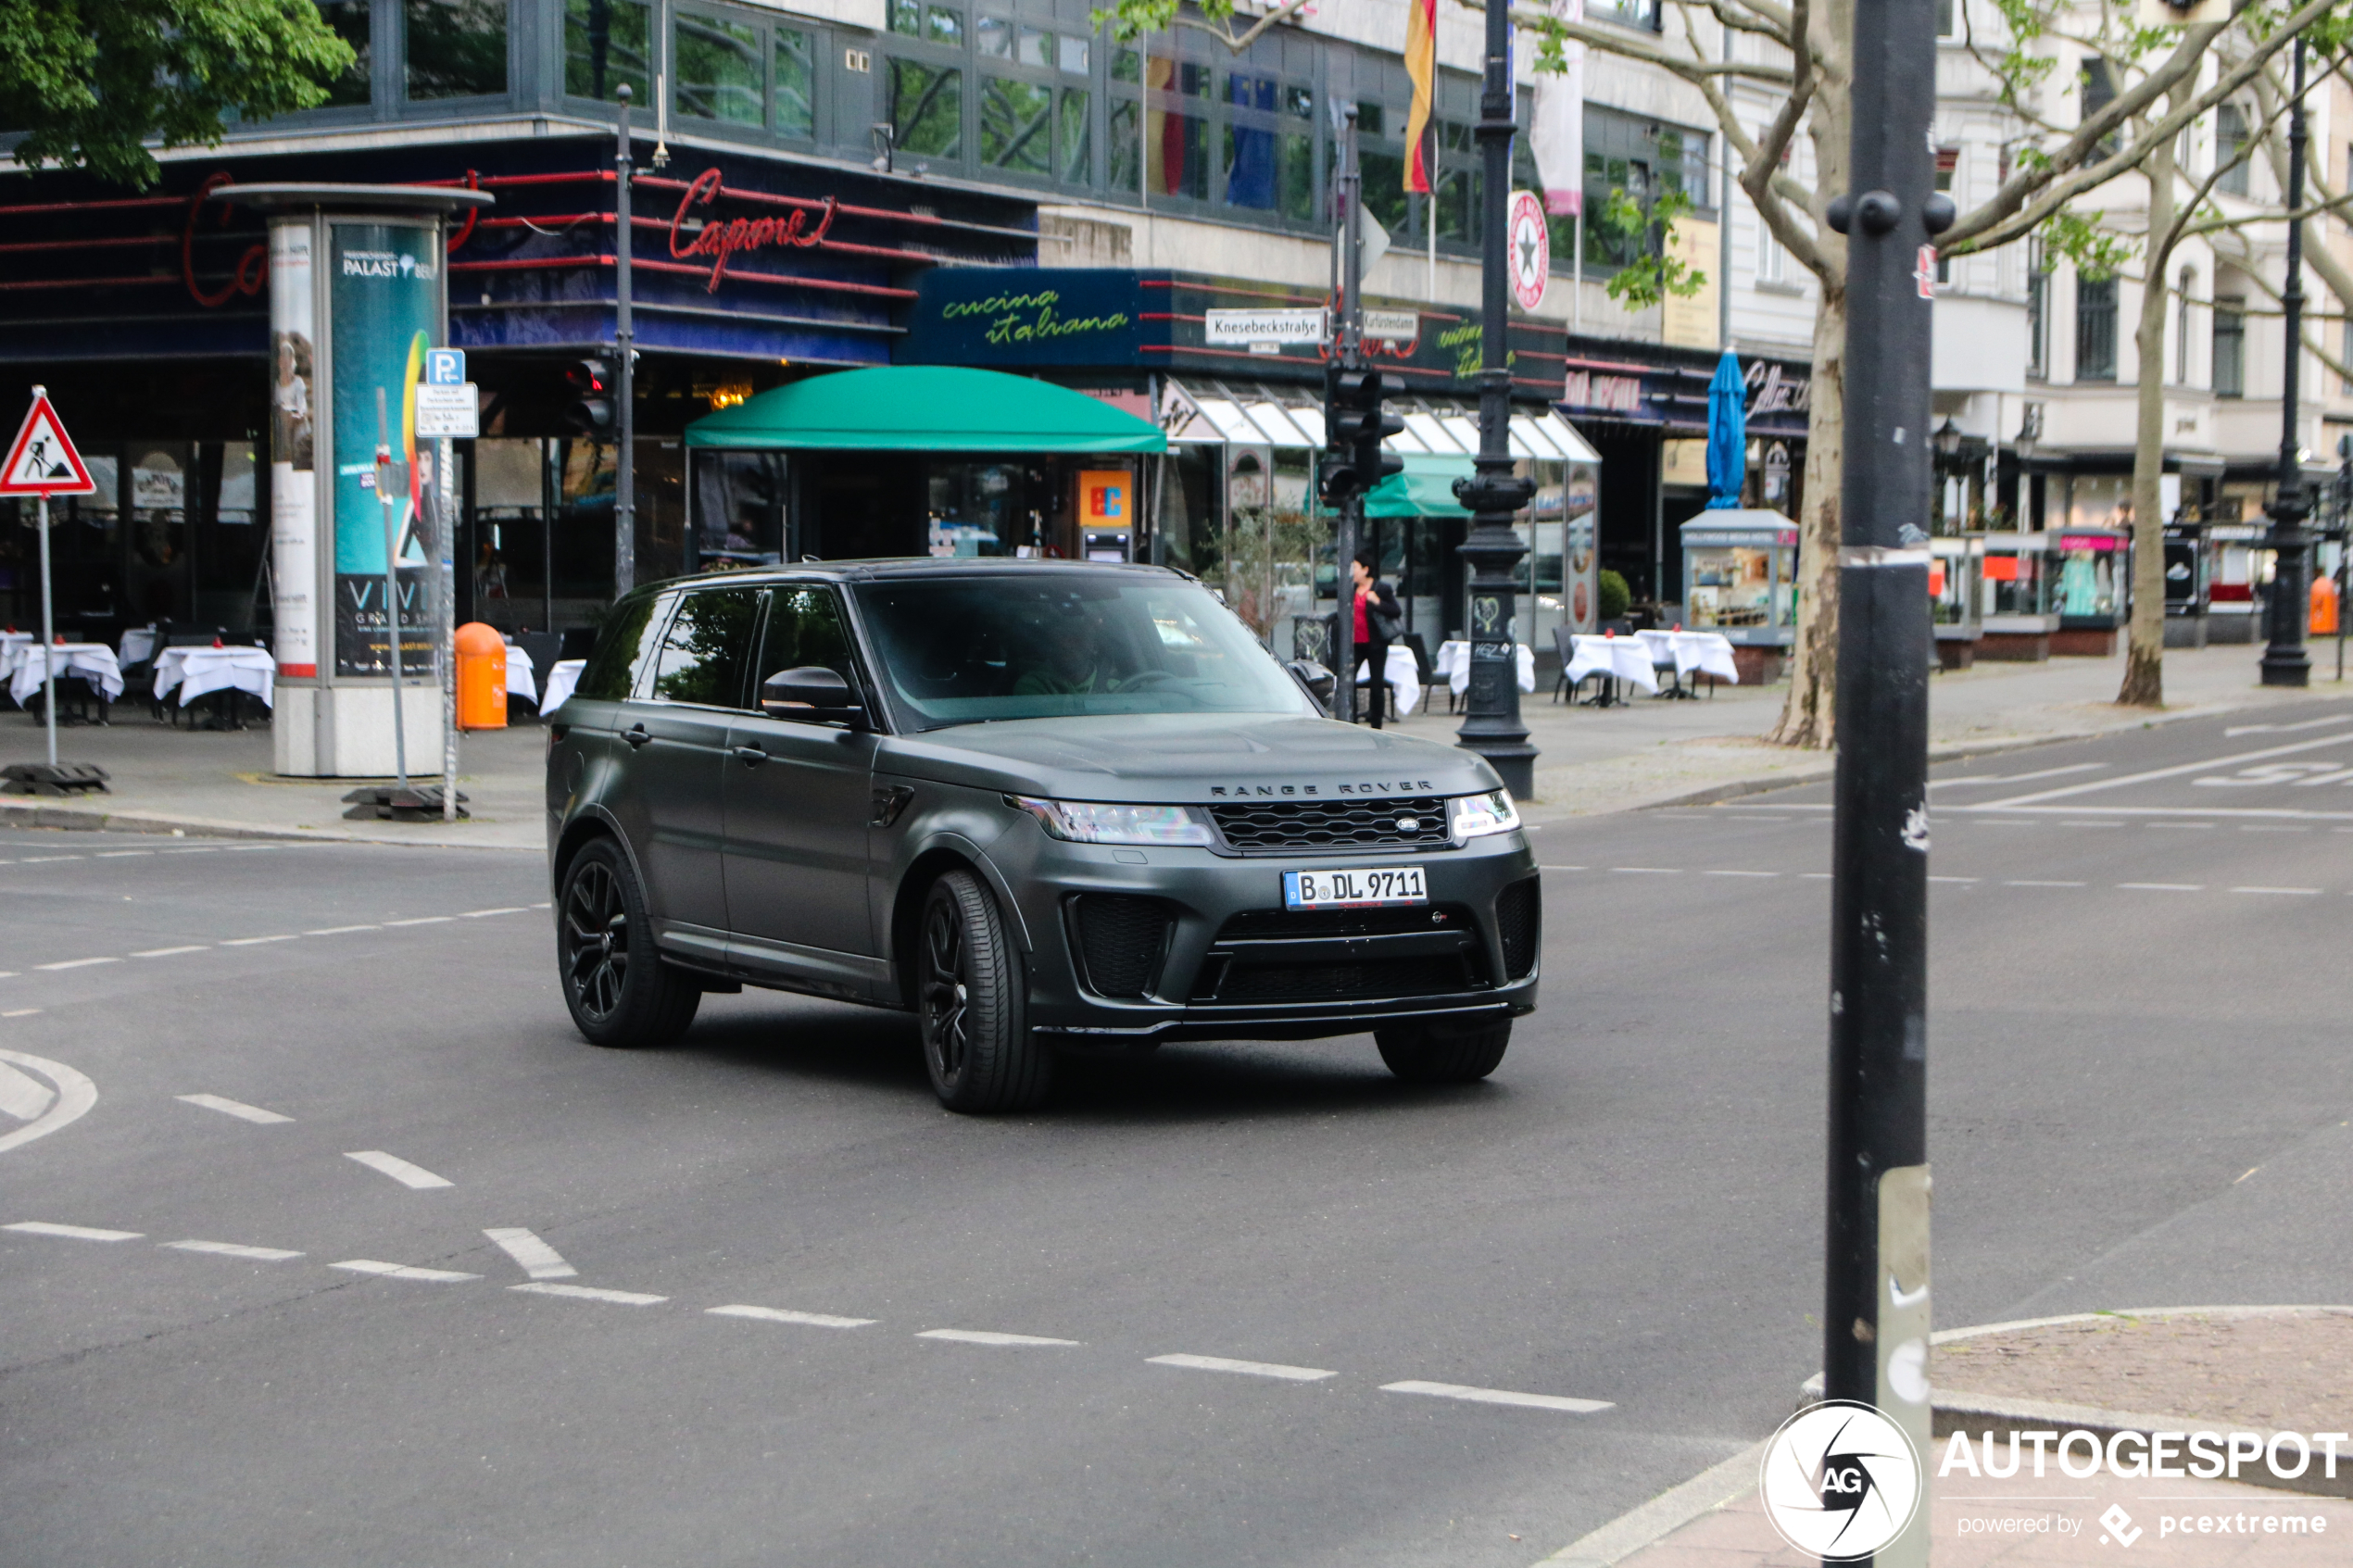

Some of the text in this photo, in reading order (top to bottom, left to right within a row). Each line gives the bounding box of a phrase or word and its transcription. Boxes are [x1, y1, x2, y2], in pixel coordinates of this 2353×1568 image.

[343, 259, 398, 278] PALAST
[943, 290, 1059, 319] cucina
[985, 306, 1128, 344] italiana
[1215, 319, 1316, 336] Knesebeckstraße
[349, 580, 428, 609] VIVI
[355, 612, 409, 624] GRAD
[1211, 780, 1433, 797] RANGE ROVER
[1301, 871, 1424, 900] B DL 9711
